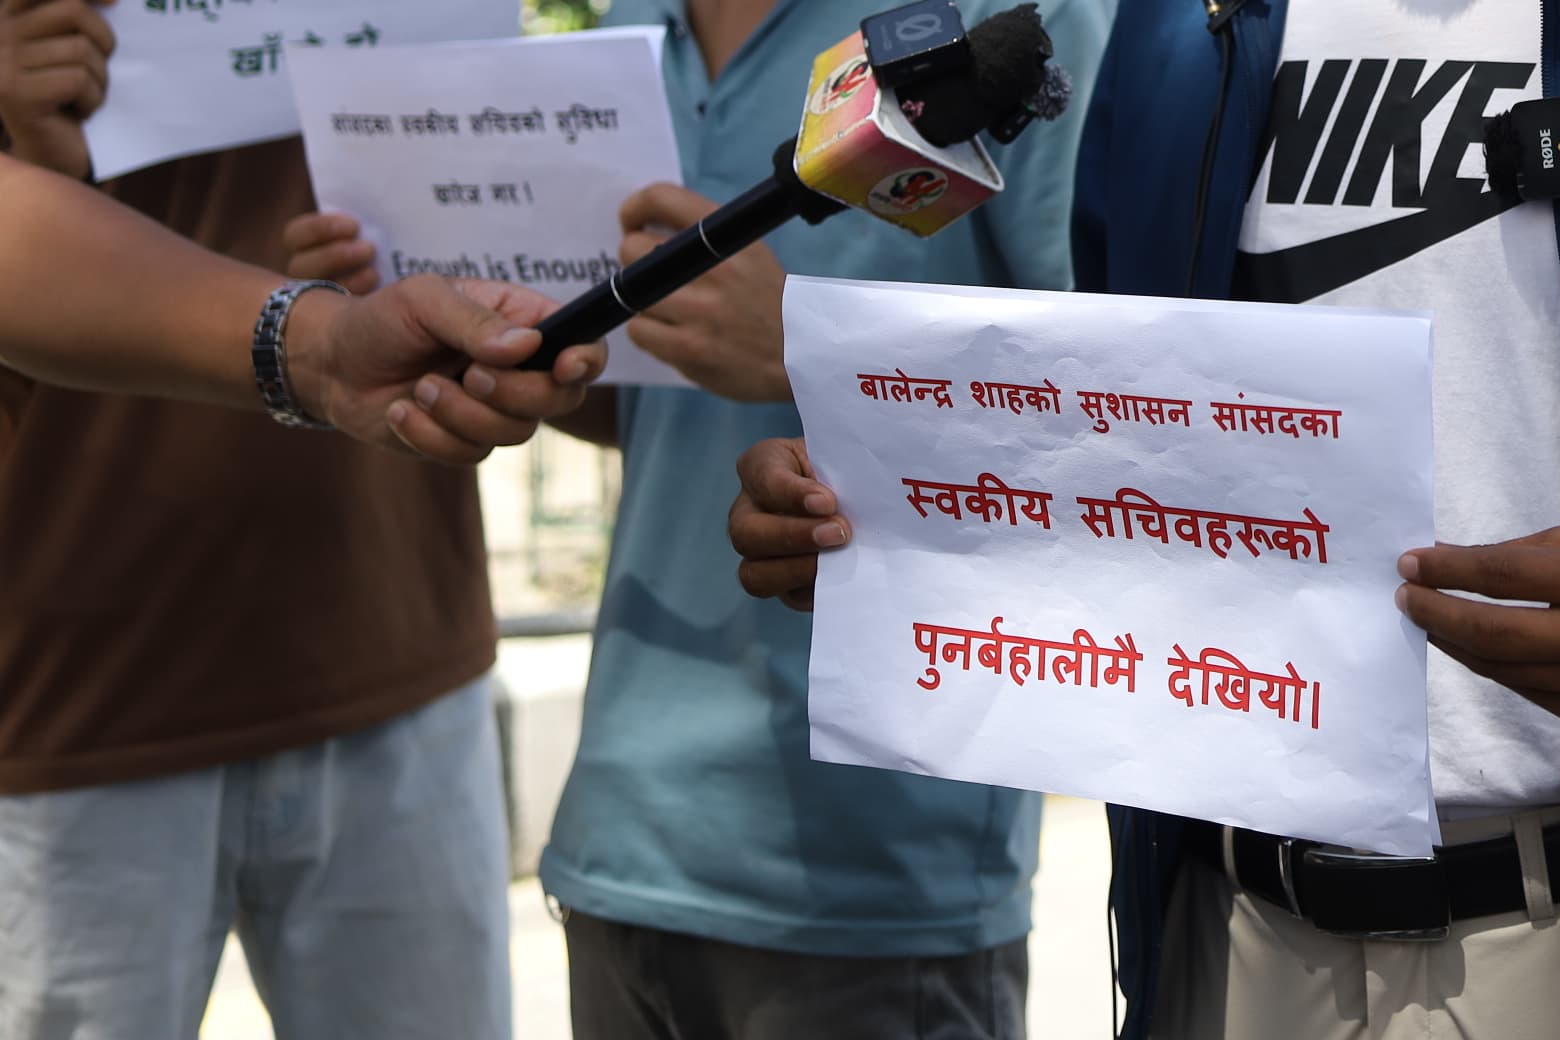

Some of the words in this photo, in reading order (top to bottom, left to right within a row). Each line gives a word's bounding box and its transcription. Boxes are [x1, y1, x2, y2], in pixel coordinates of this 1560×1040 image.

[1248, 58, 1537, 210] NIKE
[1540, 128, 1555, 169] RØDE
[484, 253, 510, 282] is
[514, 250, 621, 284] Enough
[857, 367, 953, 409] बालेन्द्र
[970, 378, 1062, 415] शाहको
[1077, 390, 1193, 434] सुशासन
[1210, 391, 1342, 439] सांसदका
[901, 472, 1053, 530] स्वकीय
[1076, 487, 1331, 565] सचिवहरूको
[913, 616, 1144, 692] पुनर्बहालीमै
[1167, 642, 1322, 730] देखियो।
